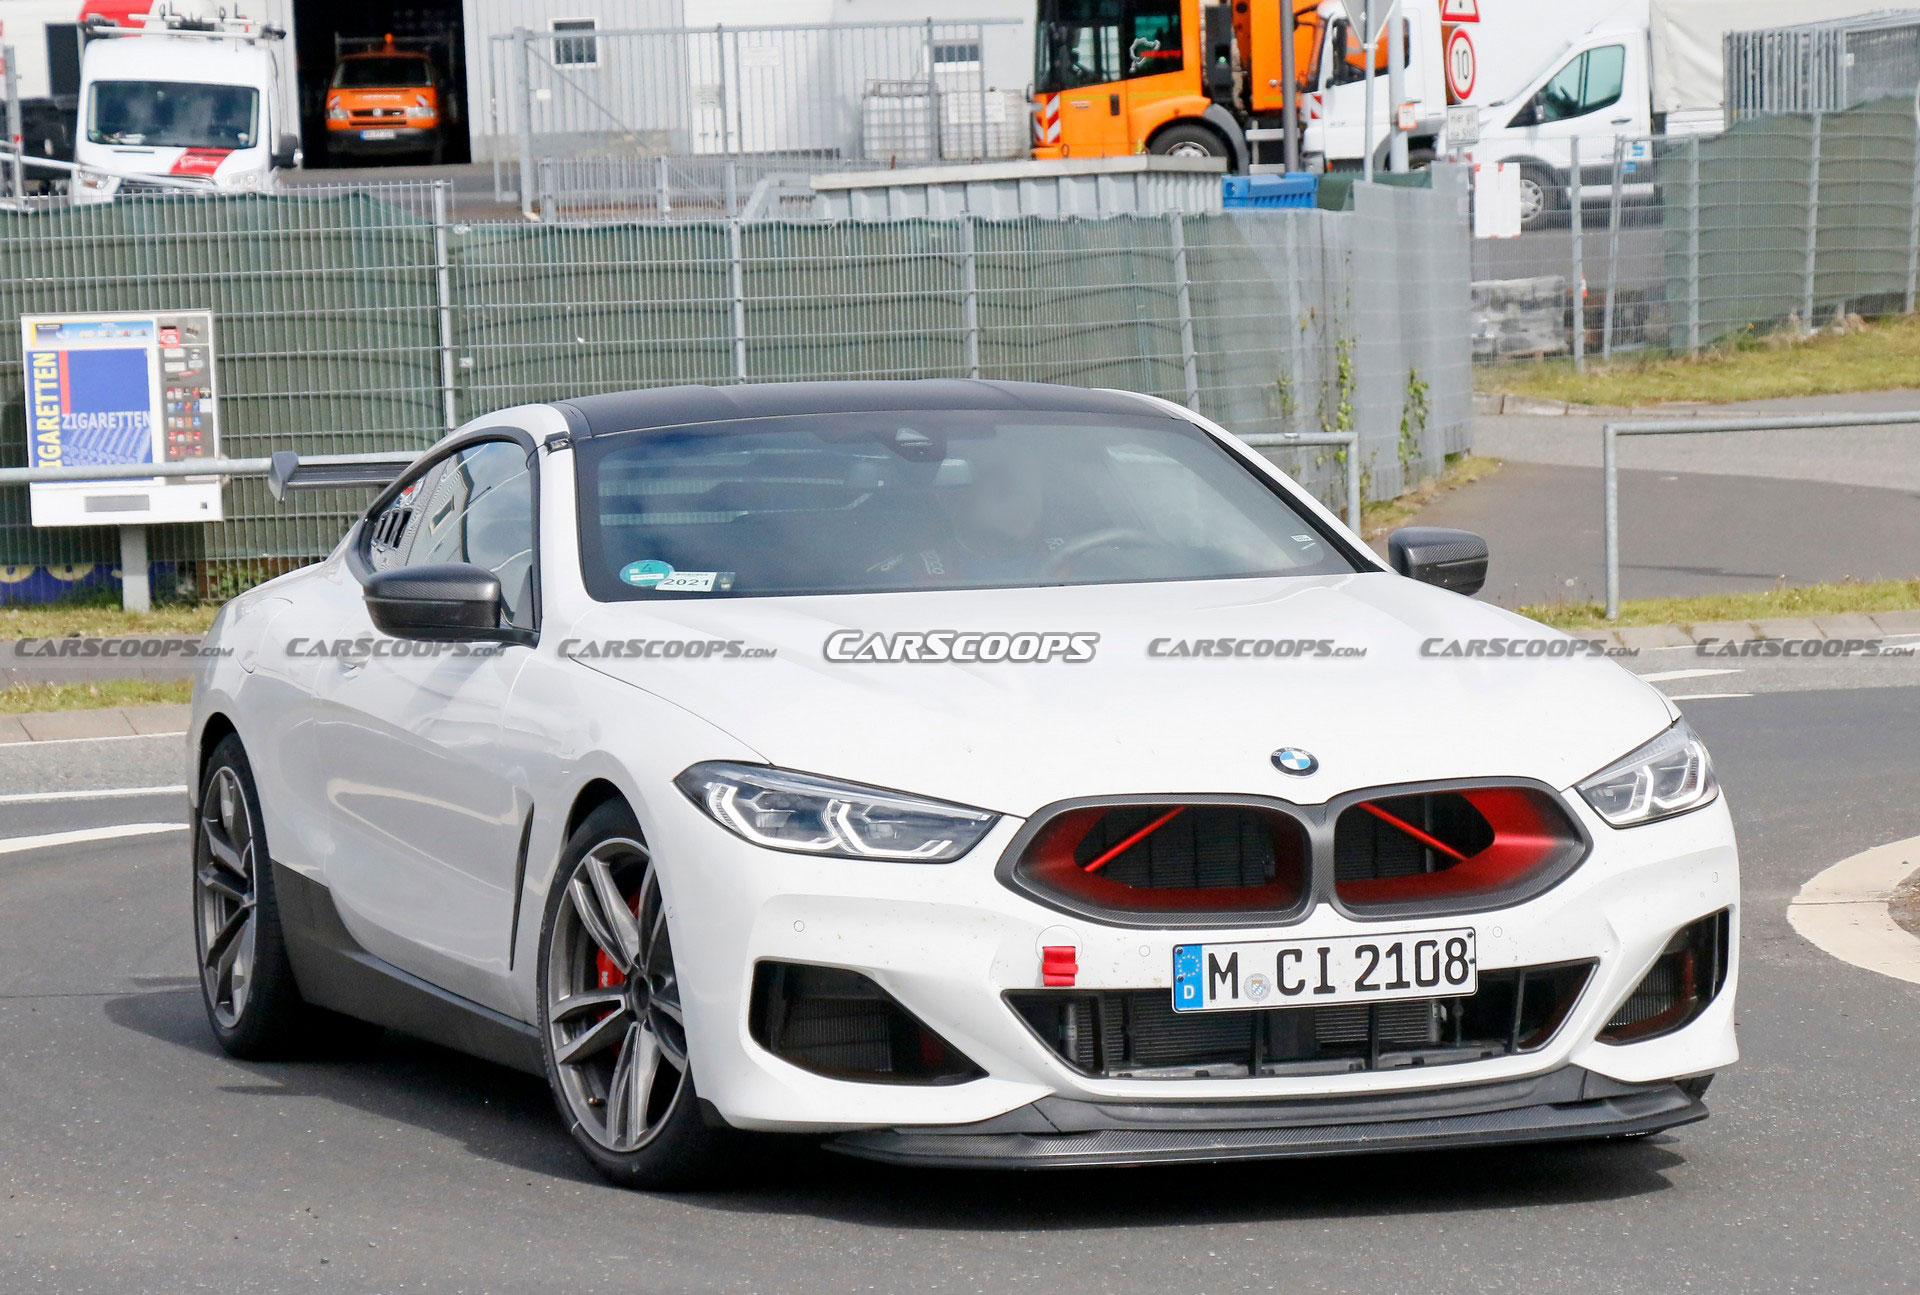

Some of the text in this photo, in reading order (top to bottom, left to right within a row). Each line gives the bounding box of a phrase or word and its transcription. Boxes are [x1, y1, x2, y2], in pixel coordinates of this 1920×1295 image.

[1455, 49, 1469, 80] 10
[33, 353, 62, 467] IGARETTEN
[62, 411, 150, 430] ZIGARETTEN
[1208, 937, 1470, 1000] M CI 2108
[1184, 985, 1195, 999] D
